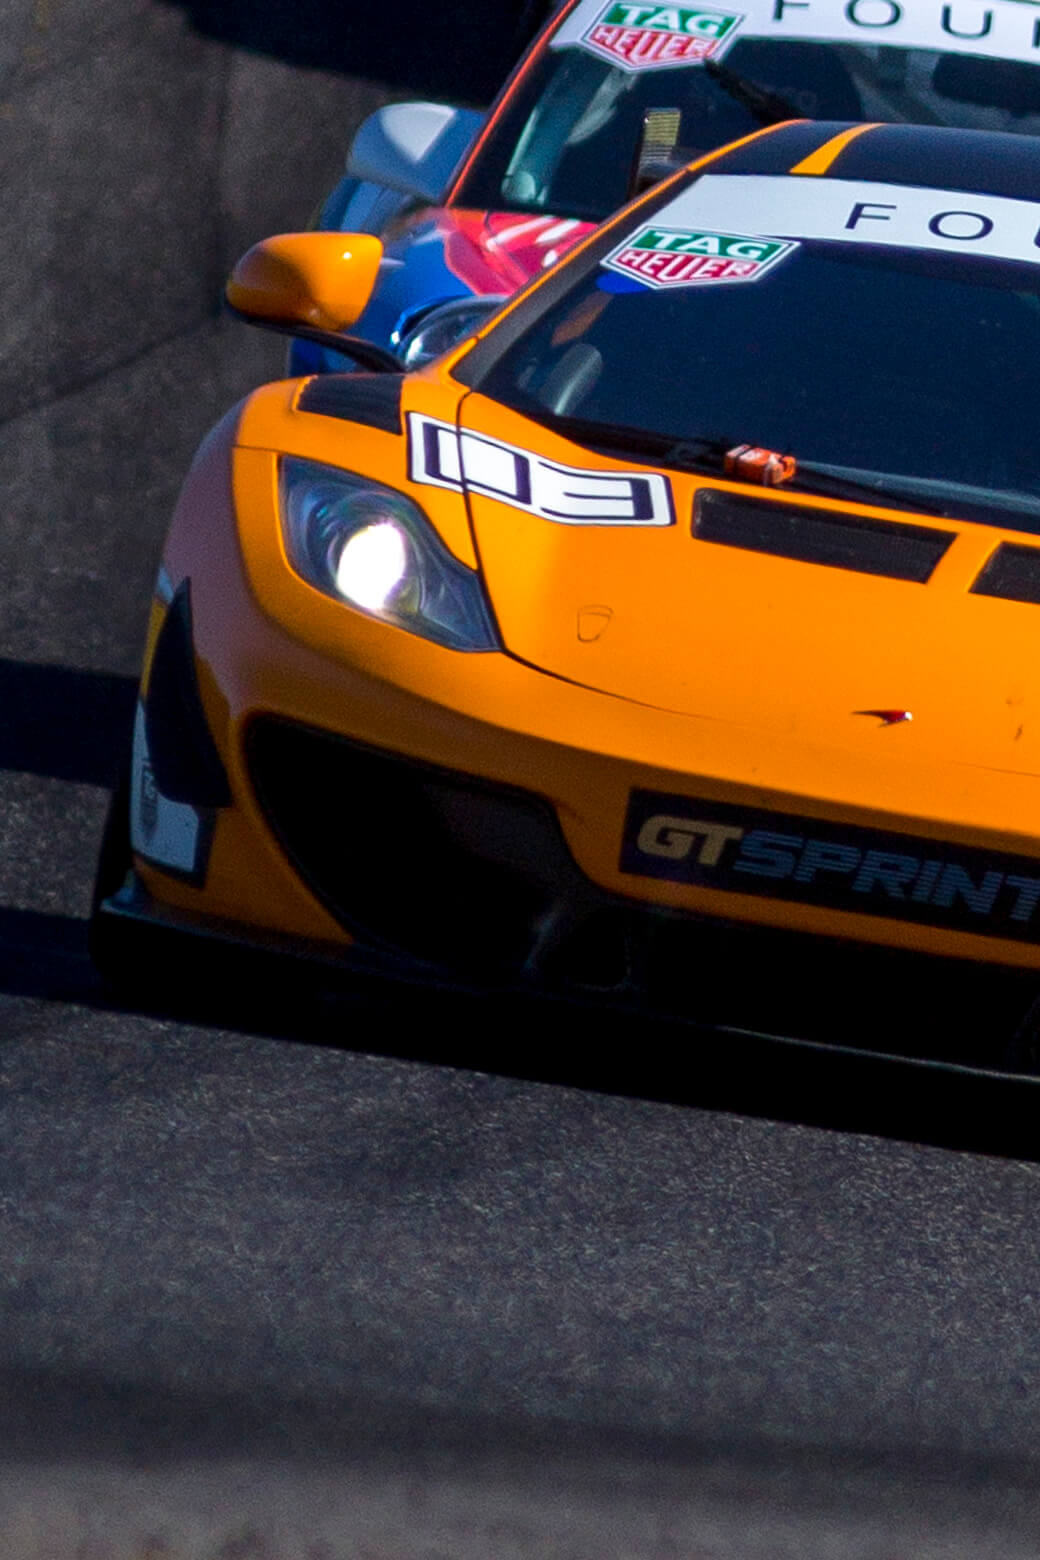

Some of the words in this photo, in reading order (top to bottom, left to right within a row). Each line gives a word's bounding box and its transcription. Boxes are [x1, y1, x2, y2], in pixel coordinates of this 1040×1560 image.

[618, 3, 728, 36] TAG
[593, 26, 720, 65] HEUER
[652, 230, 769, 259] TAG
[618, 250, 756, 282] HEUER
